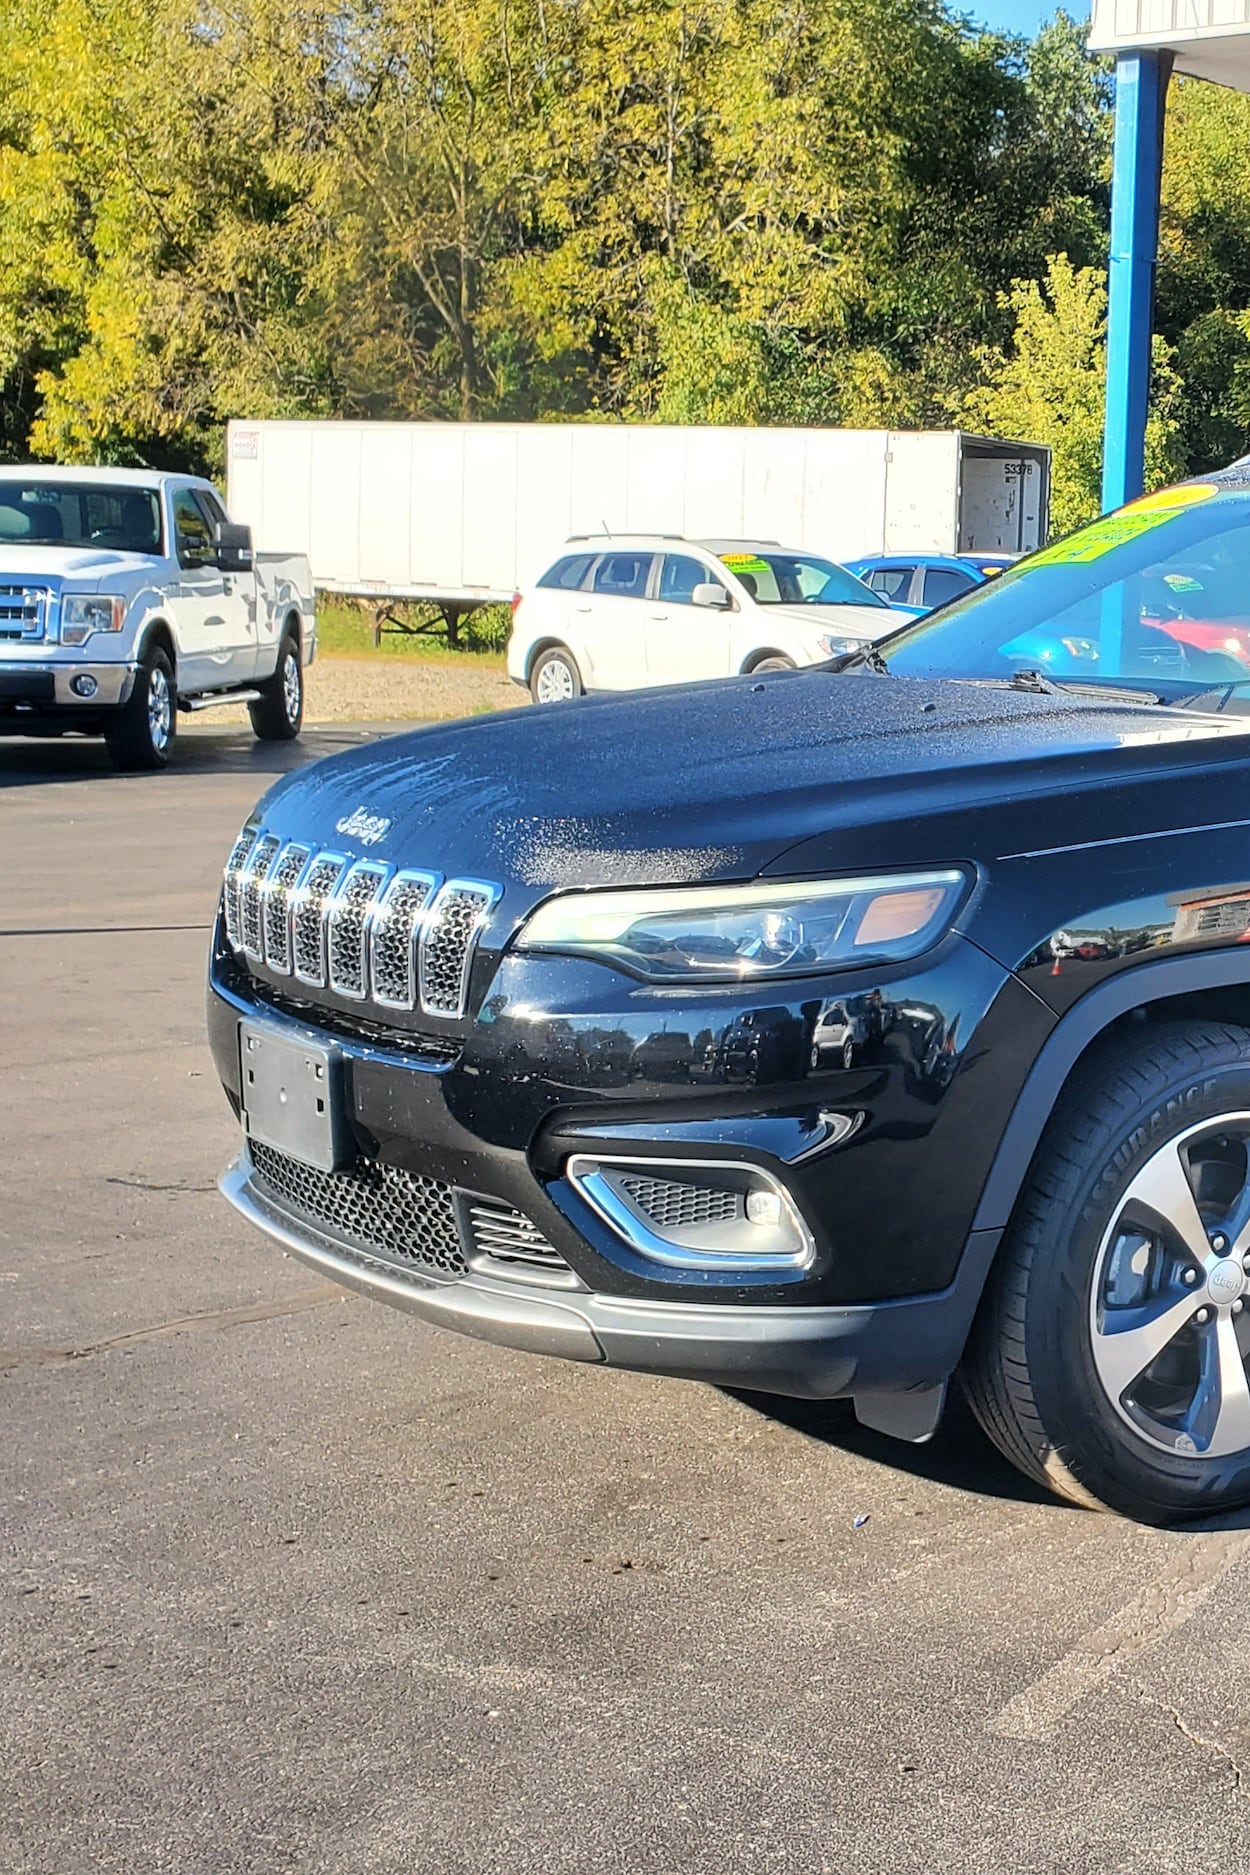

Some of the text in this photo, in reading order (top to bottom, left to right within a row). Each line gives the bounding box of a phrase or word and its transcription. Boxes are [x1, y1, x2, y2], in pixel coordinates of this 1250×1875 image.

[336, 805, 391, 846] Jeep
[1081, 1078, 1218, 1222] ASSURANCE
[1213, 1274, 1240, 1293] Jeep
